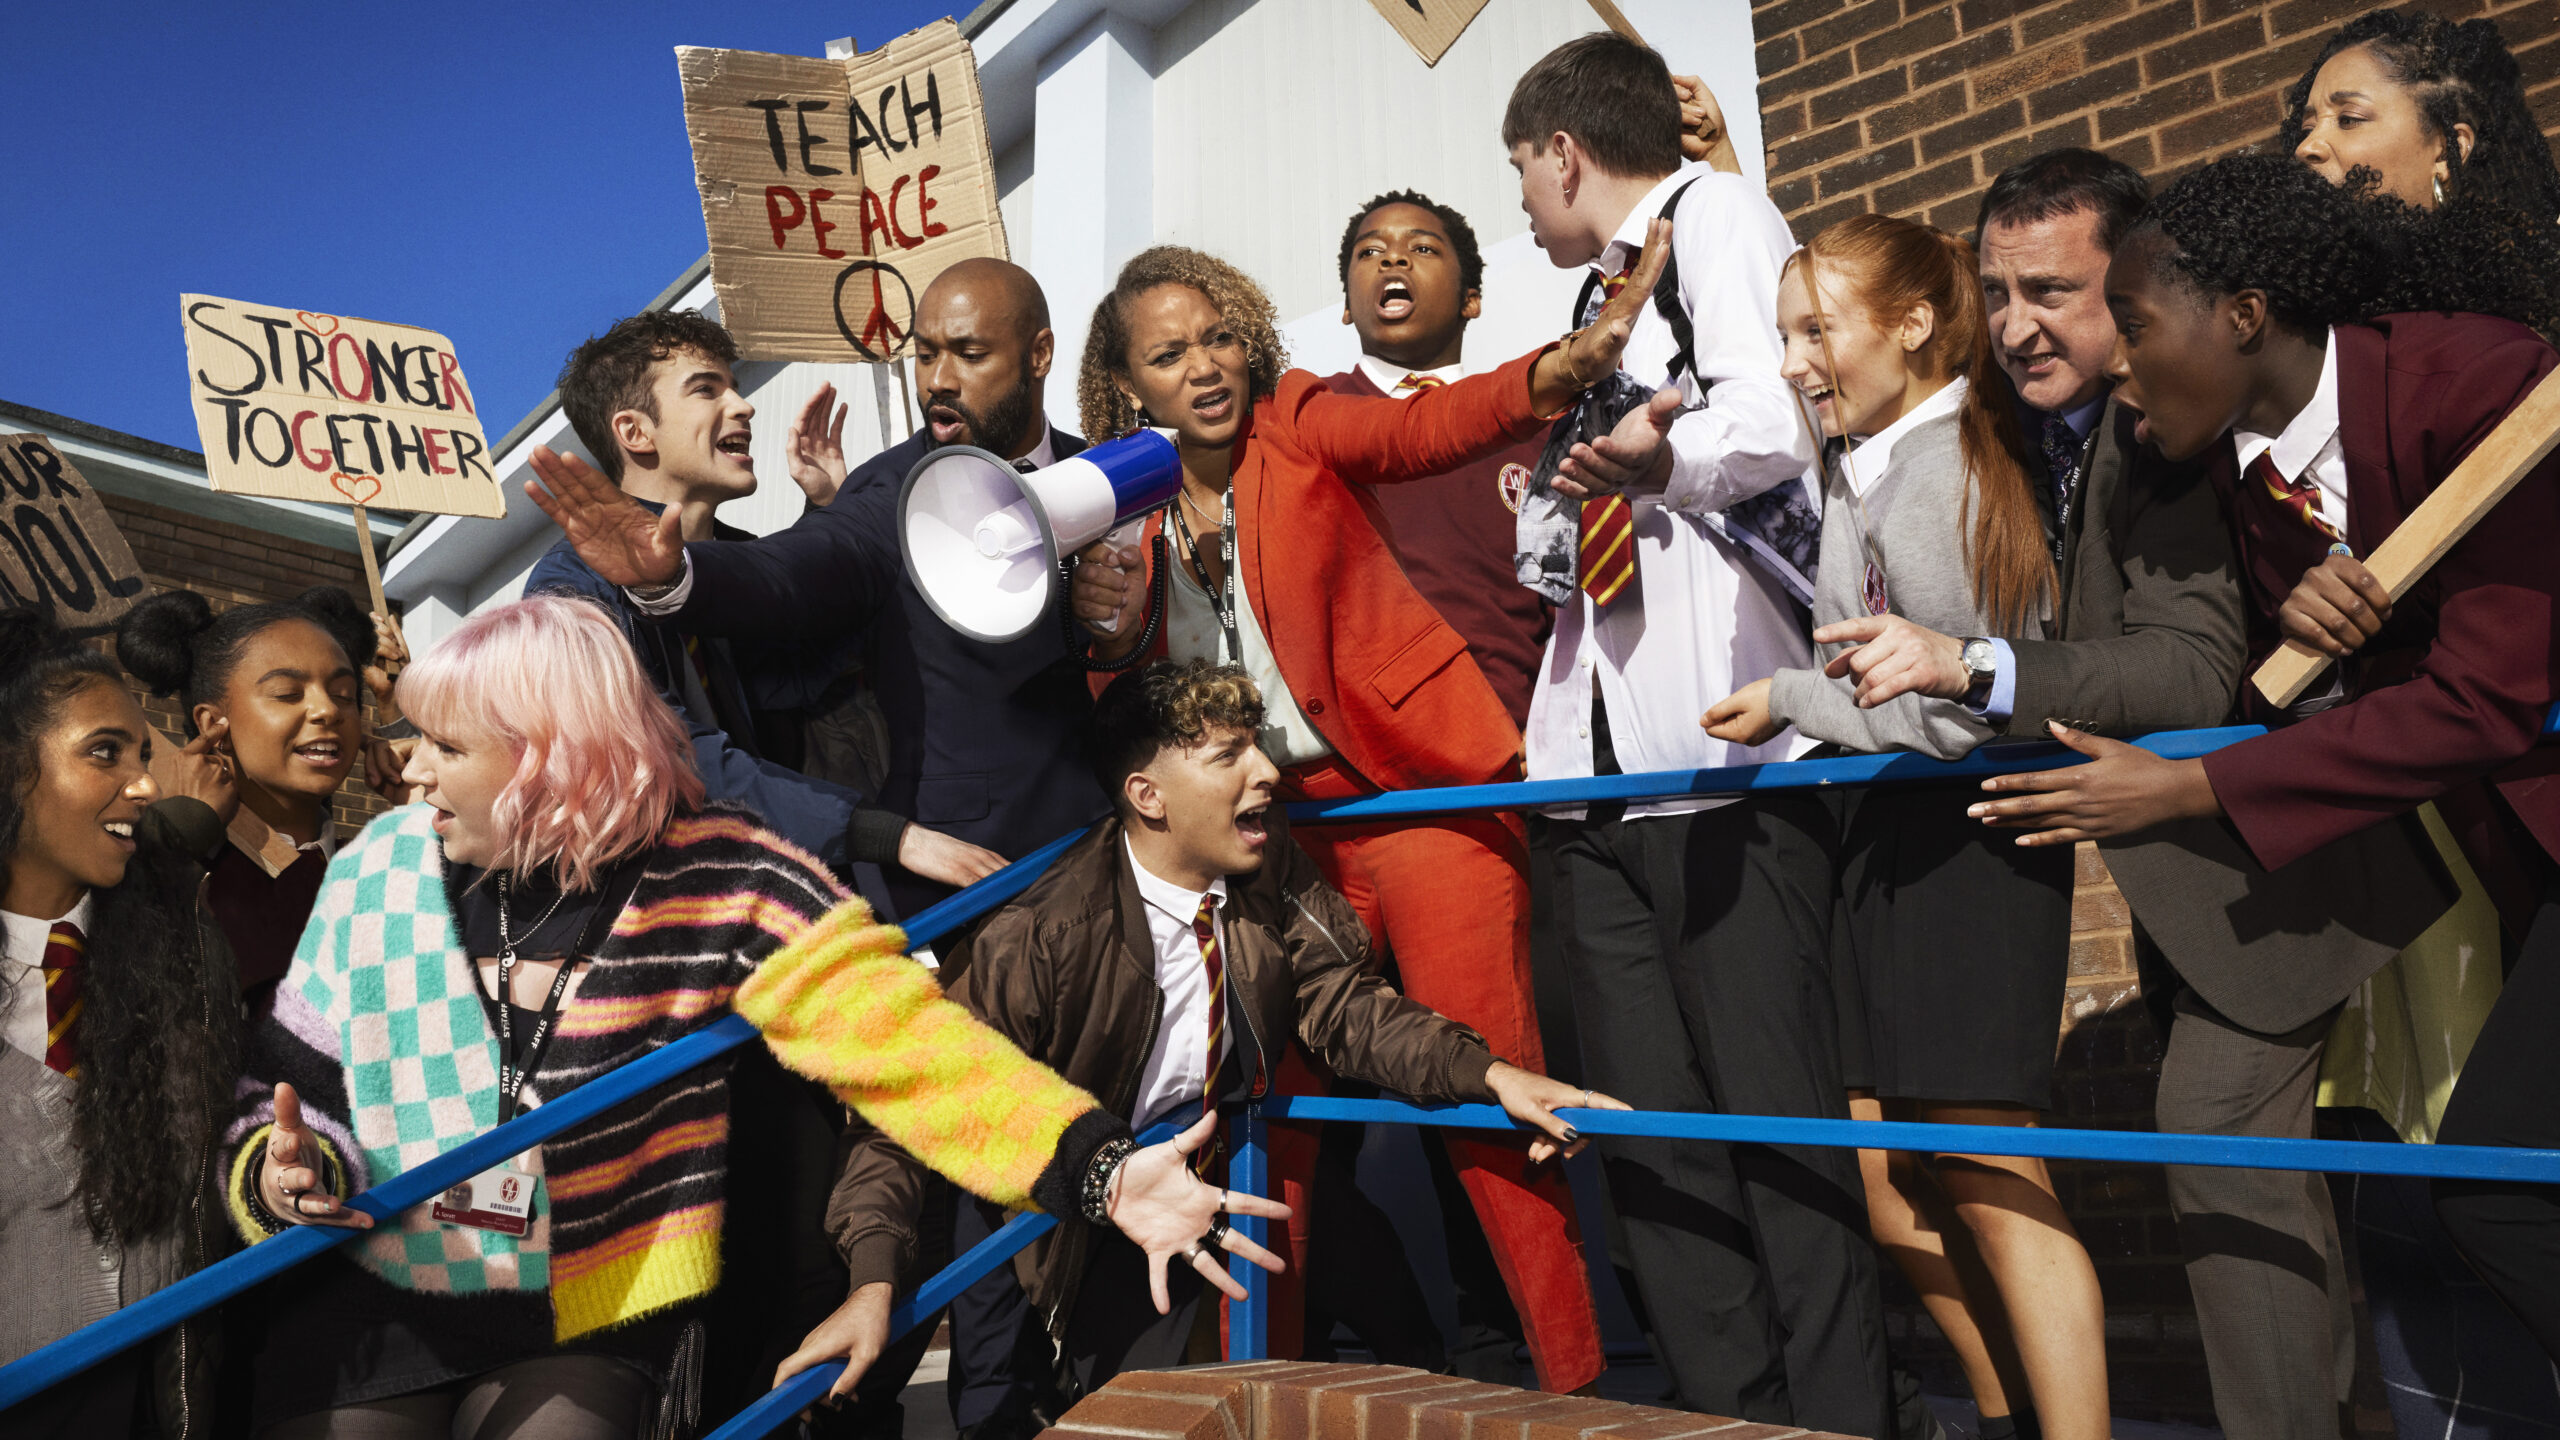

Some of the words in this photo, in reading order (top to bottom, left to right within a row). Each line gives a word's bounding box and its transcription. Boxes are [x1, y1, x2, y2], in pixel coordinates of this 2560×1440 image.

[745, 64, 942, 178] TEACH
[764, 164, 948, 260] PEACE
[188, 301, 474, 414] STRONGER
[205, 397, 493, 483] TOGETHER
[0, 441, 81, 500] UR
[2070, 466, 2081, 487] STAFF
[2061, 504, 2070, 524] STAFF
[1207, 584, 1218, 599] STAFF
[531, 1020, 547, 1049] STAFF
[502, 1065, 510, 1093] STAFF
[511, 1070, 524, 1097] STAFF
